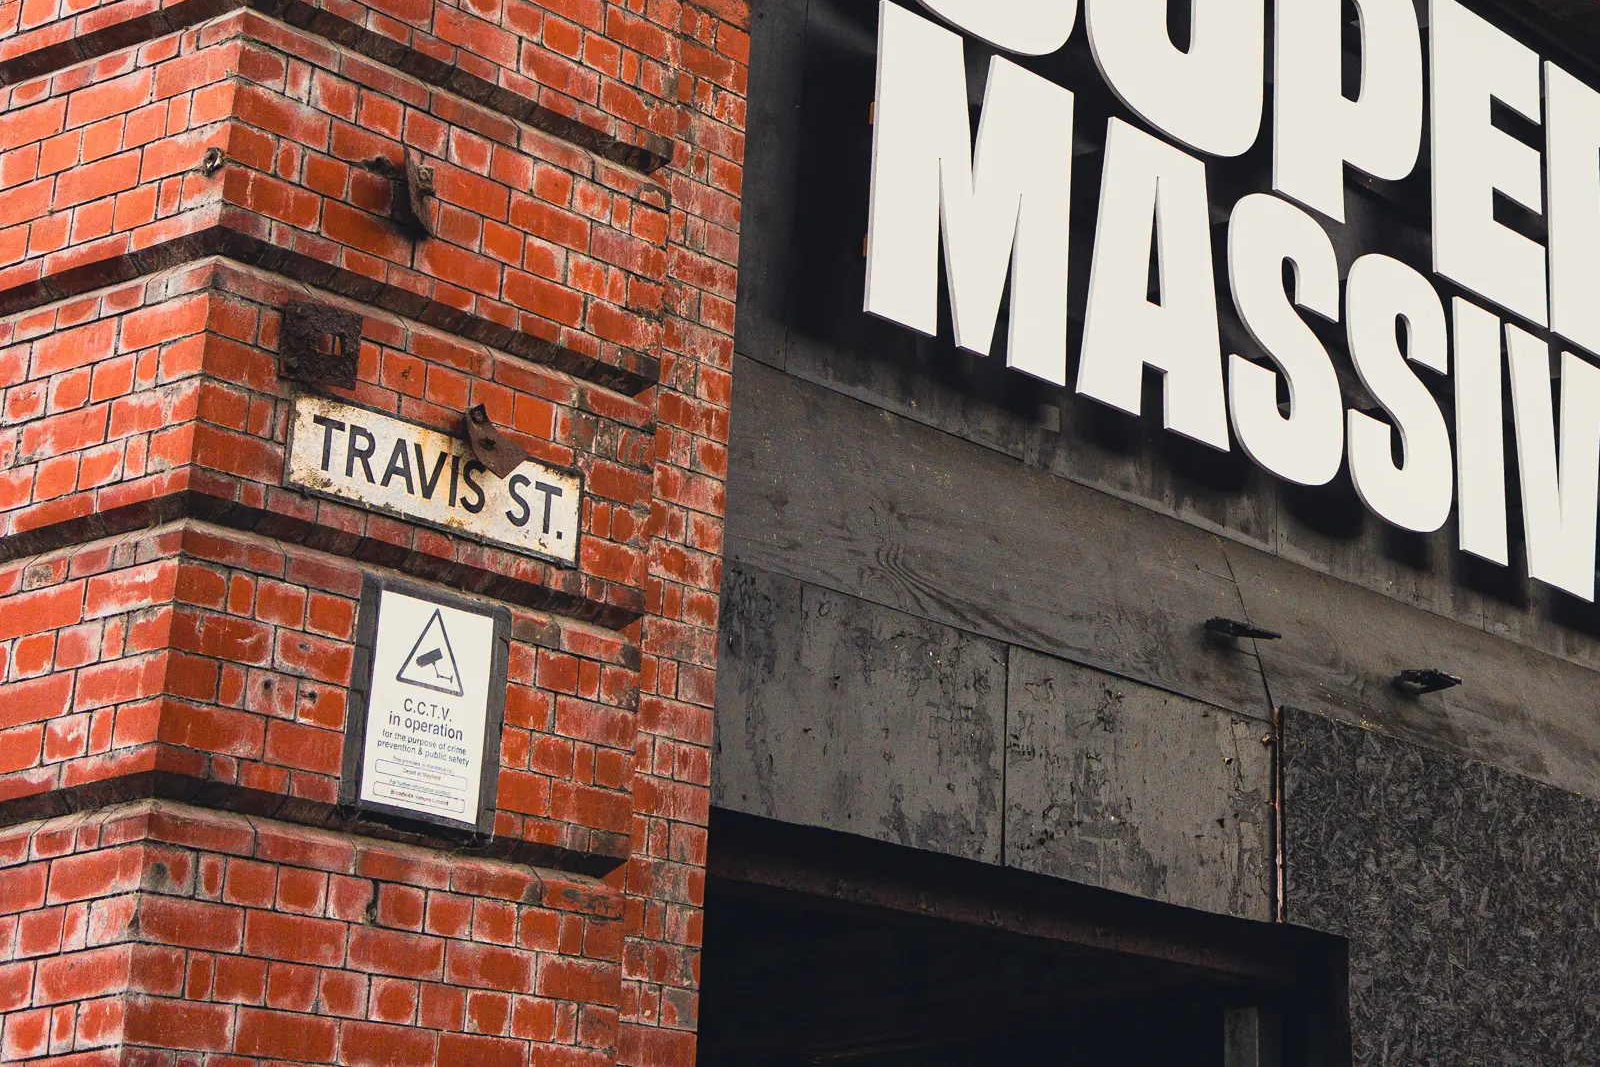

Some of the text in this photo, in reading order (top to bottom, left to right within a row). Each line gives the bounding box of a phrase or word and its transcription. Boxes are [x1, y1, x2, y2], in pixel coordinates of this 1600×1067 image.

[312, 413, 563, 540] TRAVIS ST.
[403, 698, 452, 722] C.C.T.V.
[388, 711, 463, 741] in operation
[377, 739, 470, 768] prevention & public safety
[382, 729, 467, 756] for the purpose of crime
